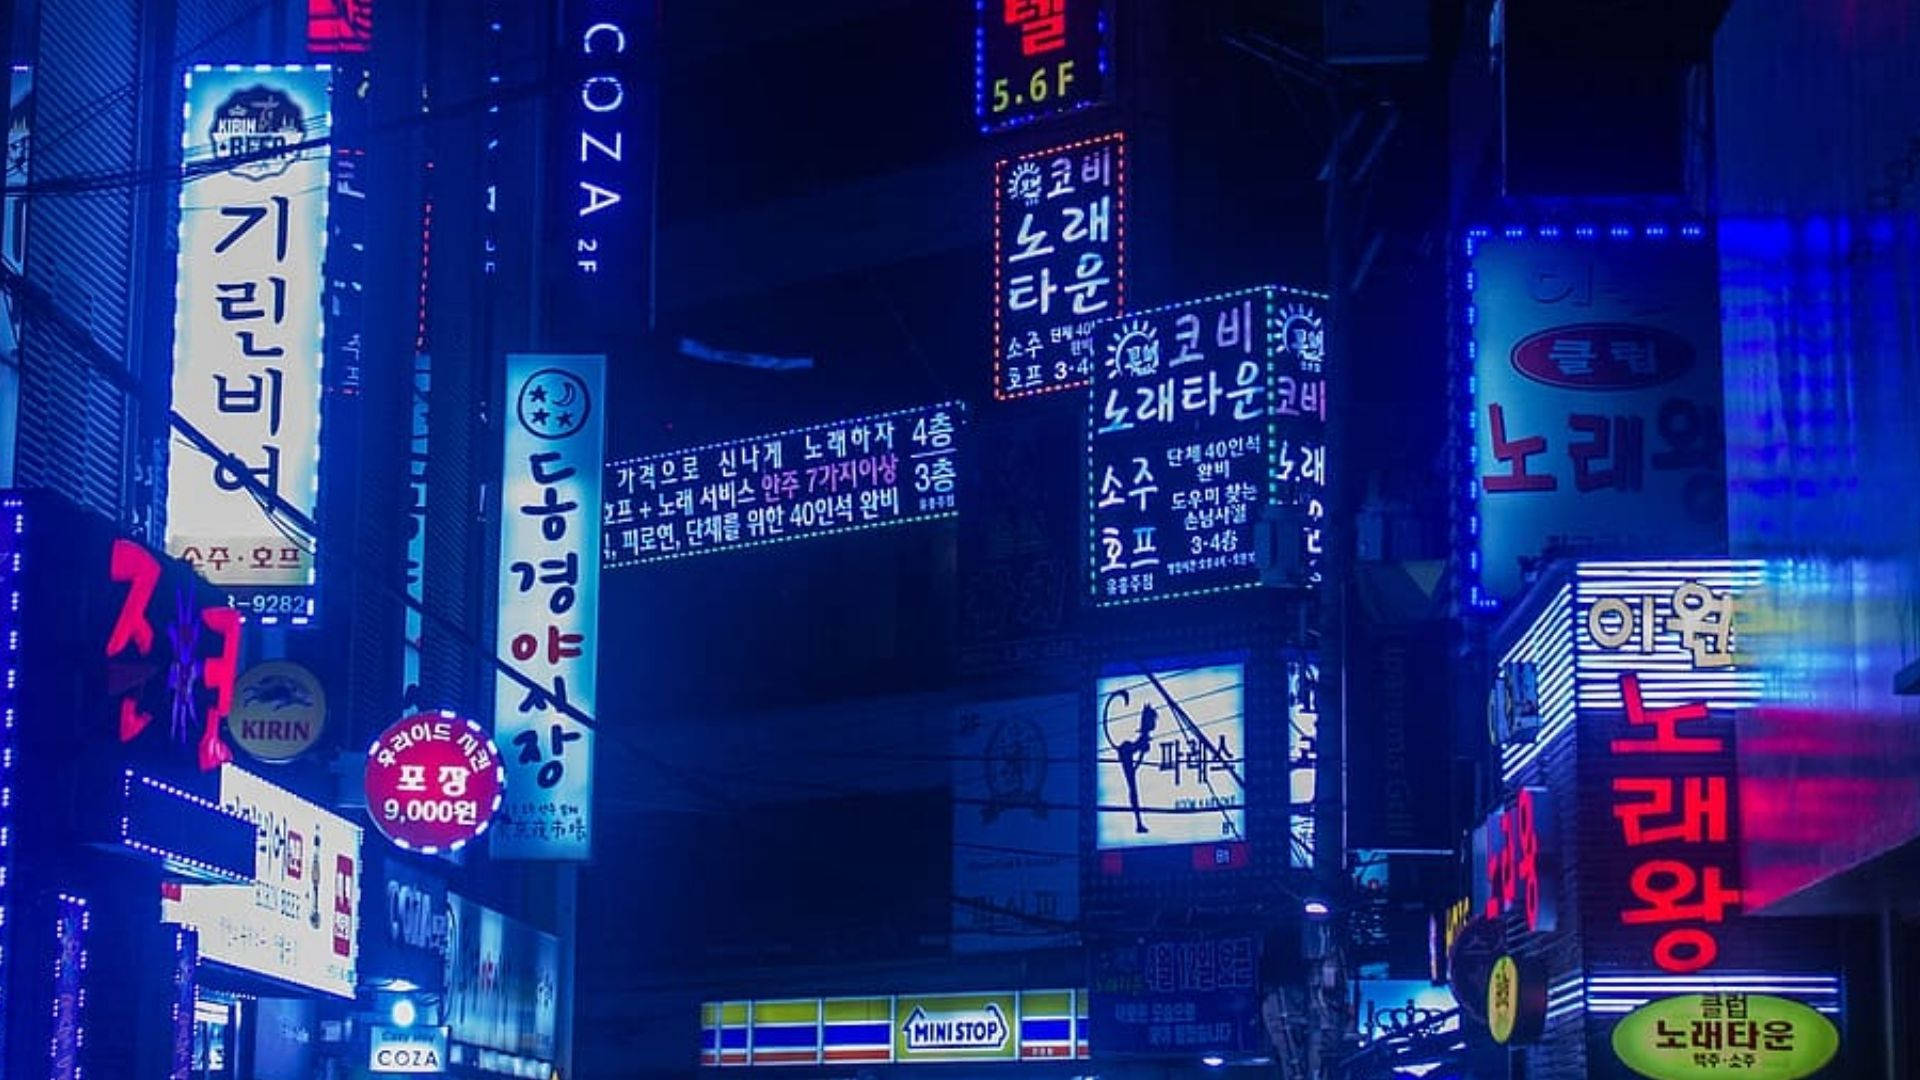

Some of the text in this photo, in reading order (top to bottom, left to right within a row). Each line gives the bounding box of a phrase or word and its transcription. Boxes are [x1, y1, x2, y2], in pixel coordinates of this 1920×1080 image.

[579, 22, 626, 217] COZA
[577, 238, 598, 273] 2F
[213, 196, 290, 499] 기린비어
[1007, 331, 1044, 360] 소주
[1169, 301, 1251, 368] 코비
[1098, 361, 1264, 434] 노래타운
[617, 421, 895, 493] 가격으로 신나게 노래하자
[911, 412, 955, 448] 4층
[658, 489, 693, 516] 노래
[700, 480, 756, 511] 서비스
[762, 470, 799, 502] 안주
[806, 453, 899, 493] 7가지이상
[914, 462, 957, 493] 3층
[1098, 457, 1158, 511] 소주
[686, 512, 741, 546] 단체를
[748, 504, 784, 535] 위한
[790, 498, 852, 527] 40인석
[860, 487, 899, 520] 완비
[1100, 527, 1160, 572] 호프
[511, 453, 584, 789] 동경야시장
[241, 719, 310, 742] KIRIN
[1610, 673, 1744, 973] 노래왕
[378, 1050, 438, 1067] COZA
[1656, 1020, 1794, 1051] 노래타운
